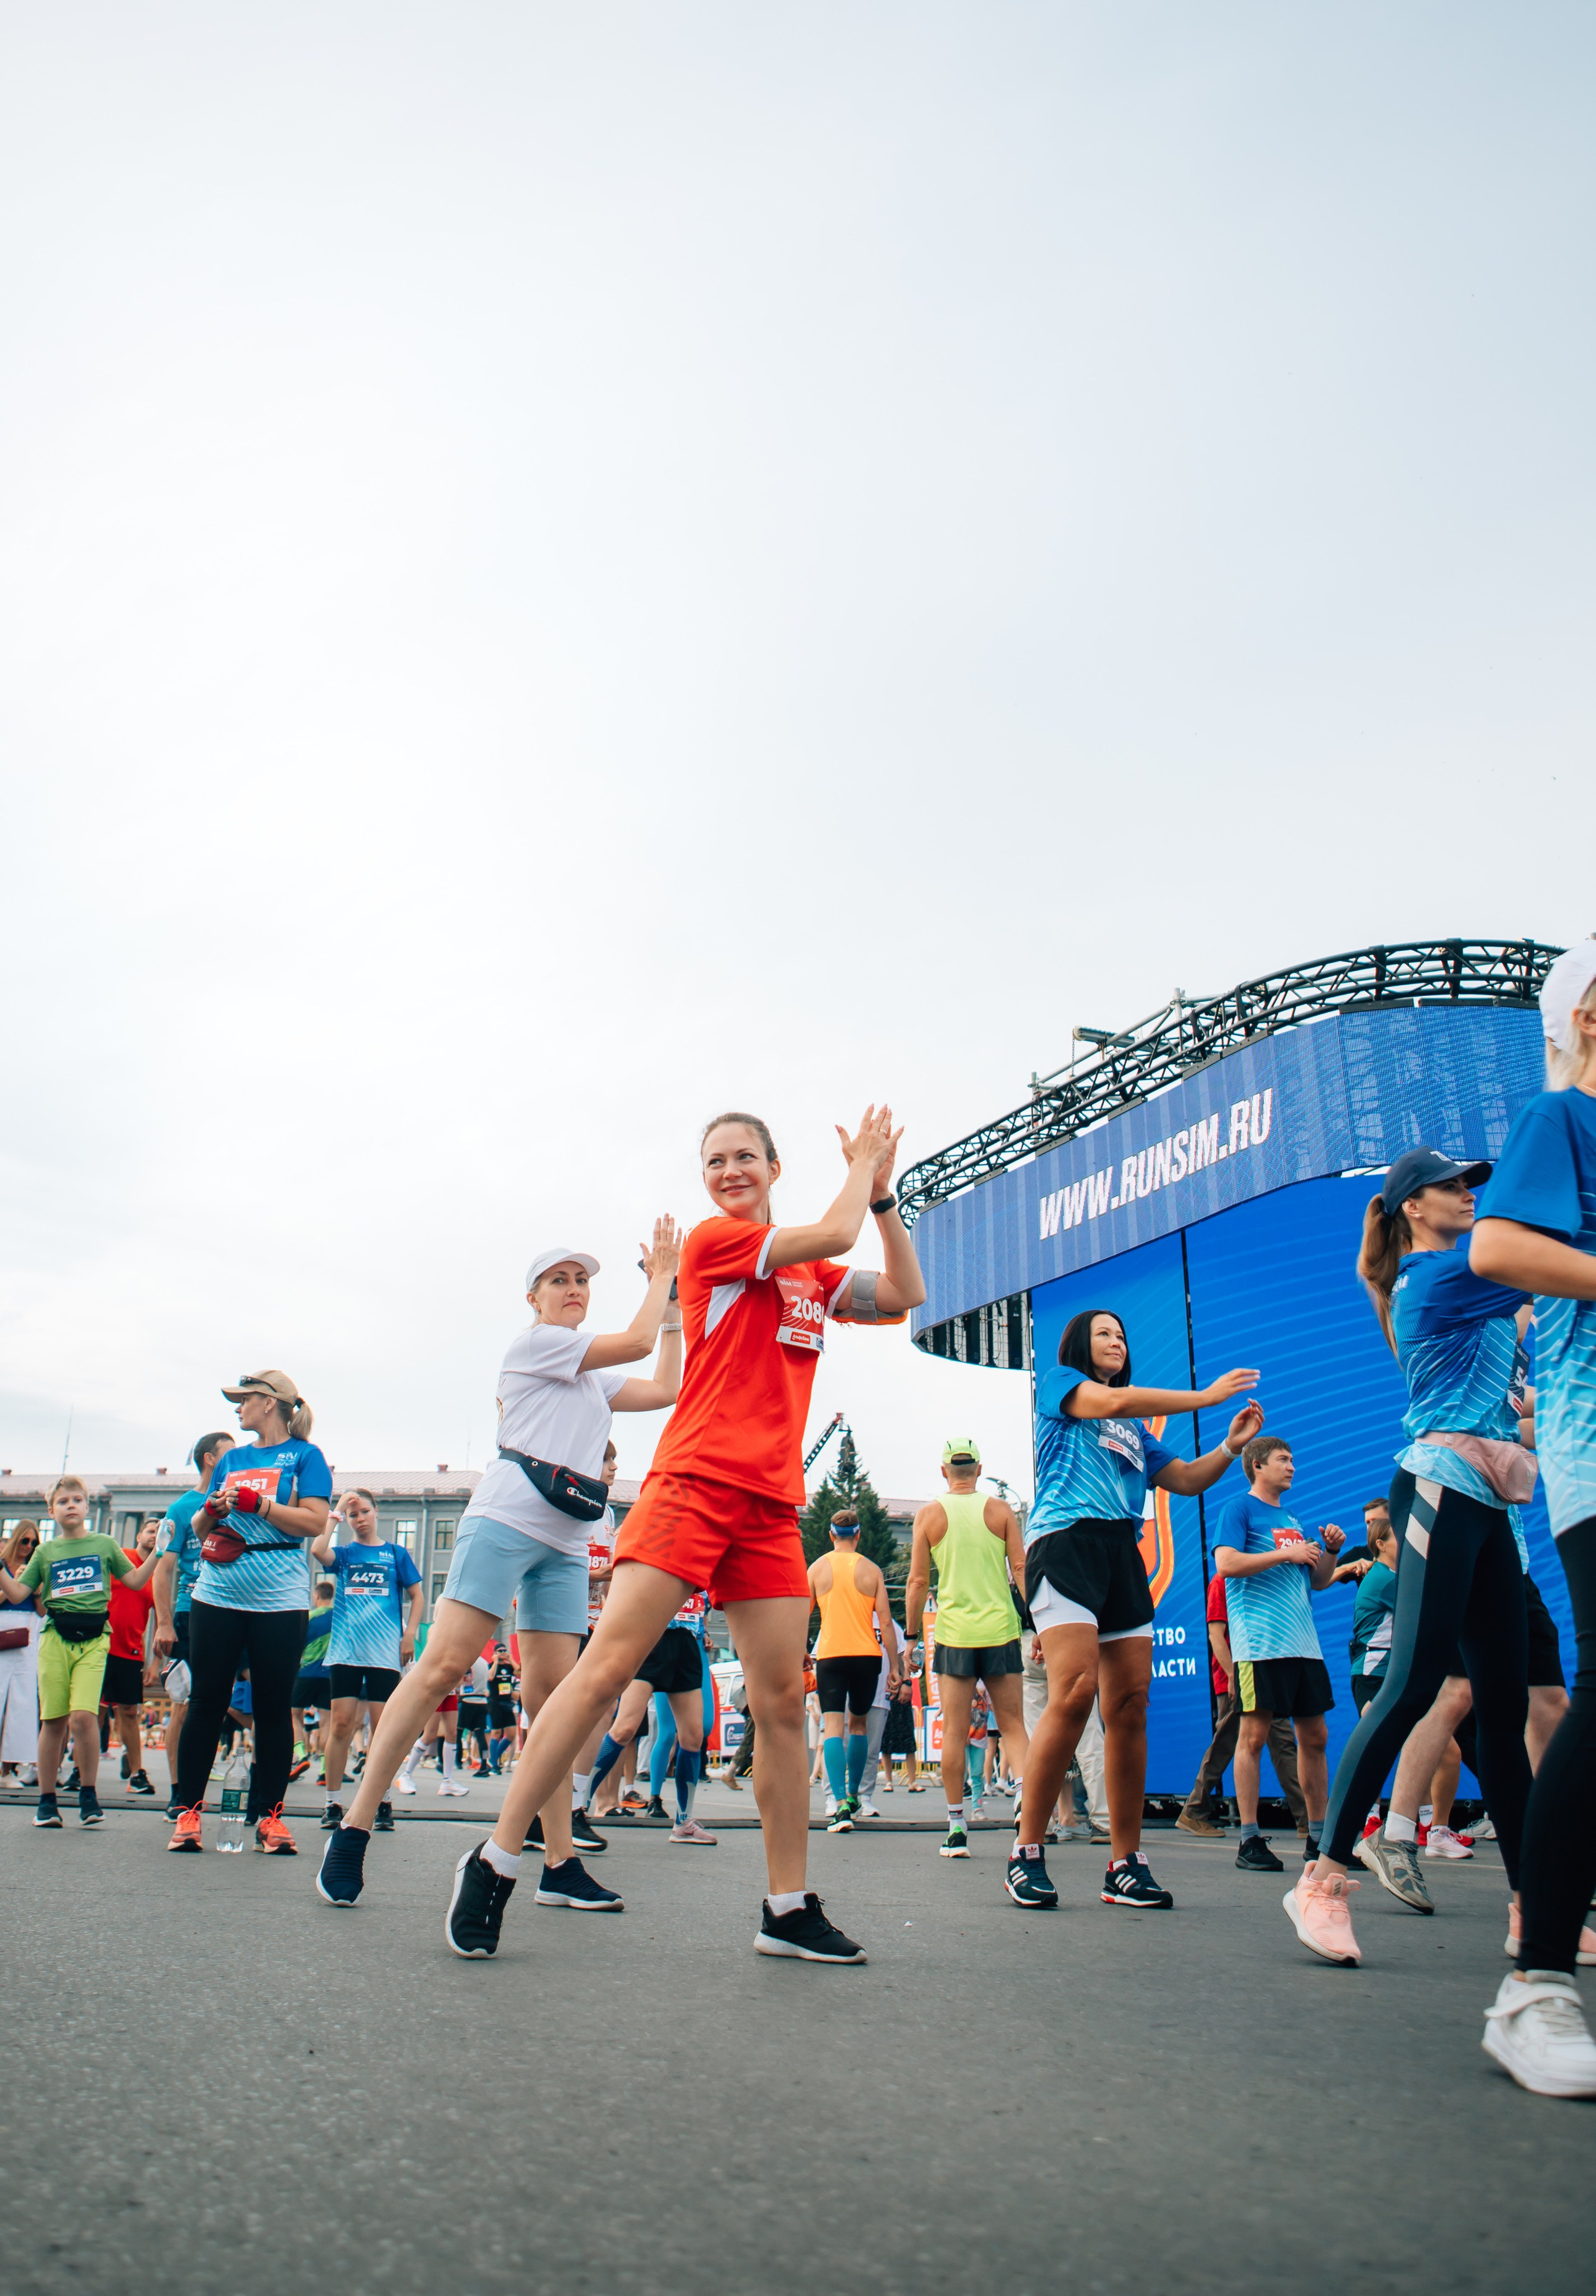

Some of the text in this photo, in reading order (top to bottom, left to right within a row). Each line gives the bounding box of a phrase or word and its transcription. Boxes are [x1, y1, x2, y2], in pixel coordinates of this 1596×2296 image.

[1040, 1088, 1272, 1240] WWW.RUNSIM.RU
[1106, 1419, 1140, 1450] 3069
[234, 1478, 268, 1490] 1951
[567, 1487, 603, 1508] Champion
[57, 1566, 94, 1583] 3229
[351, 1572, 384, 1583] 4473
